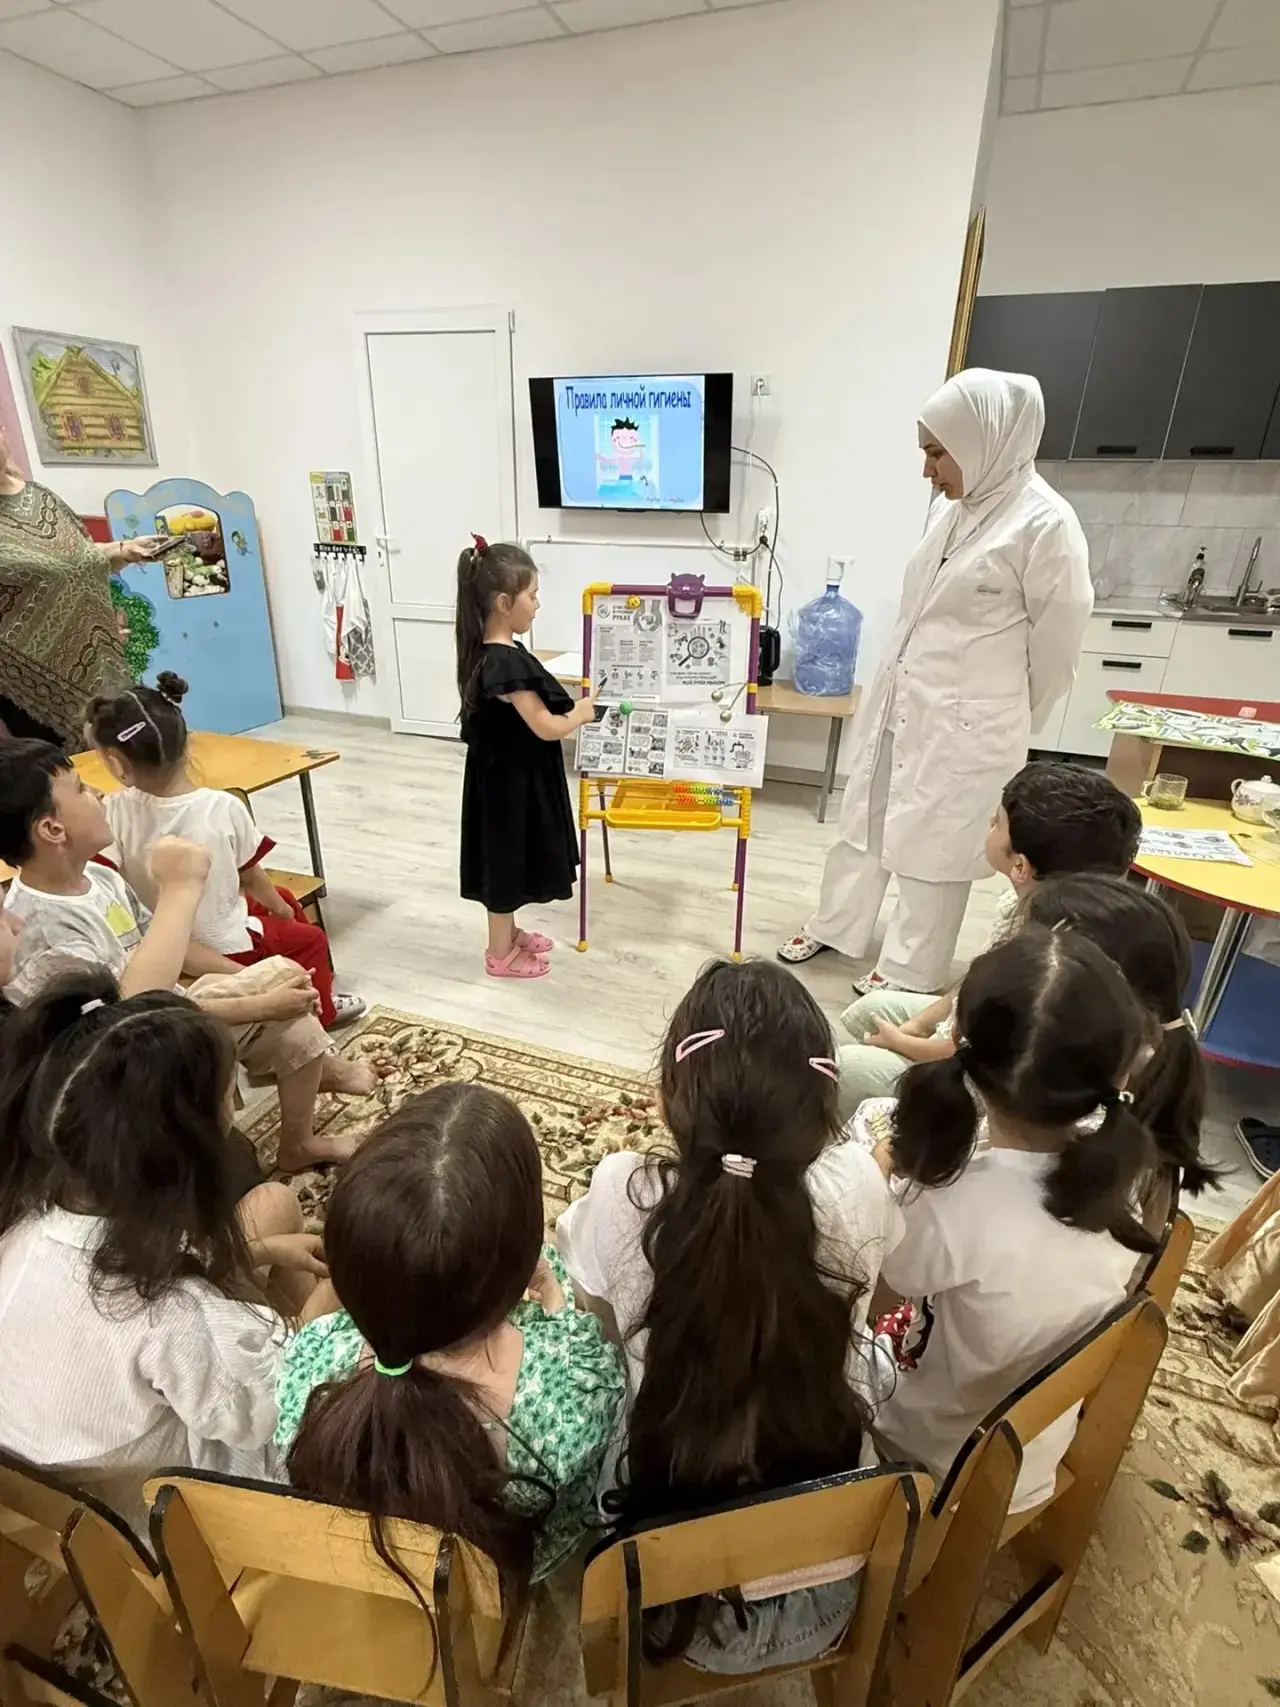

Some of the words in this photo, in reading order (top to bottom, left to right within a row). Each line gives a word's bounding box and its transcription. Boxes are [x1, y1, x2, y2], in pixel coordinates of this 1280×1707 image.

[565, 386, 607, 417] Правила
[610, 384, 646, 409] личной
[649, 391, 691, 409] гигиены
